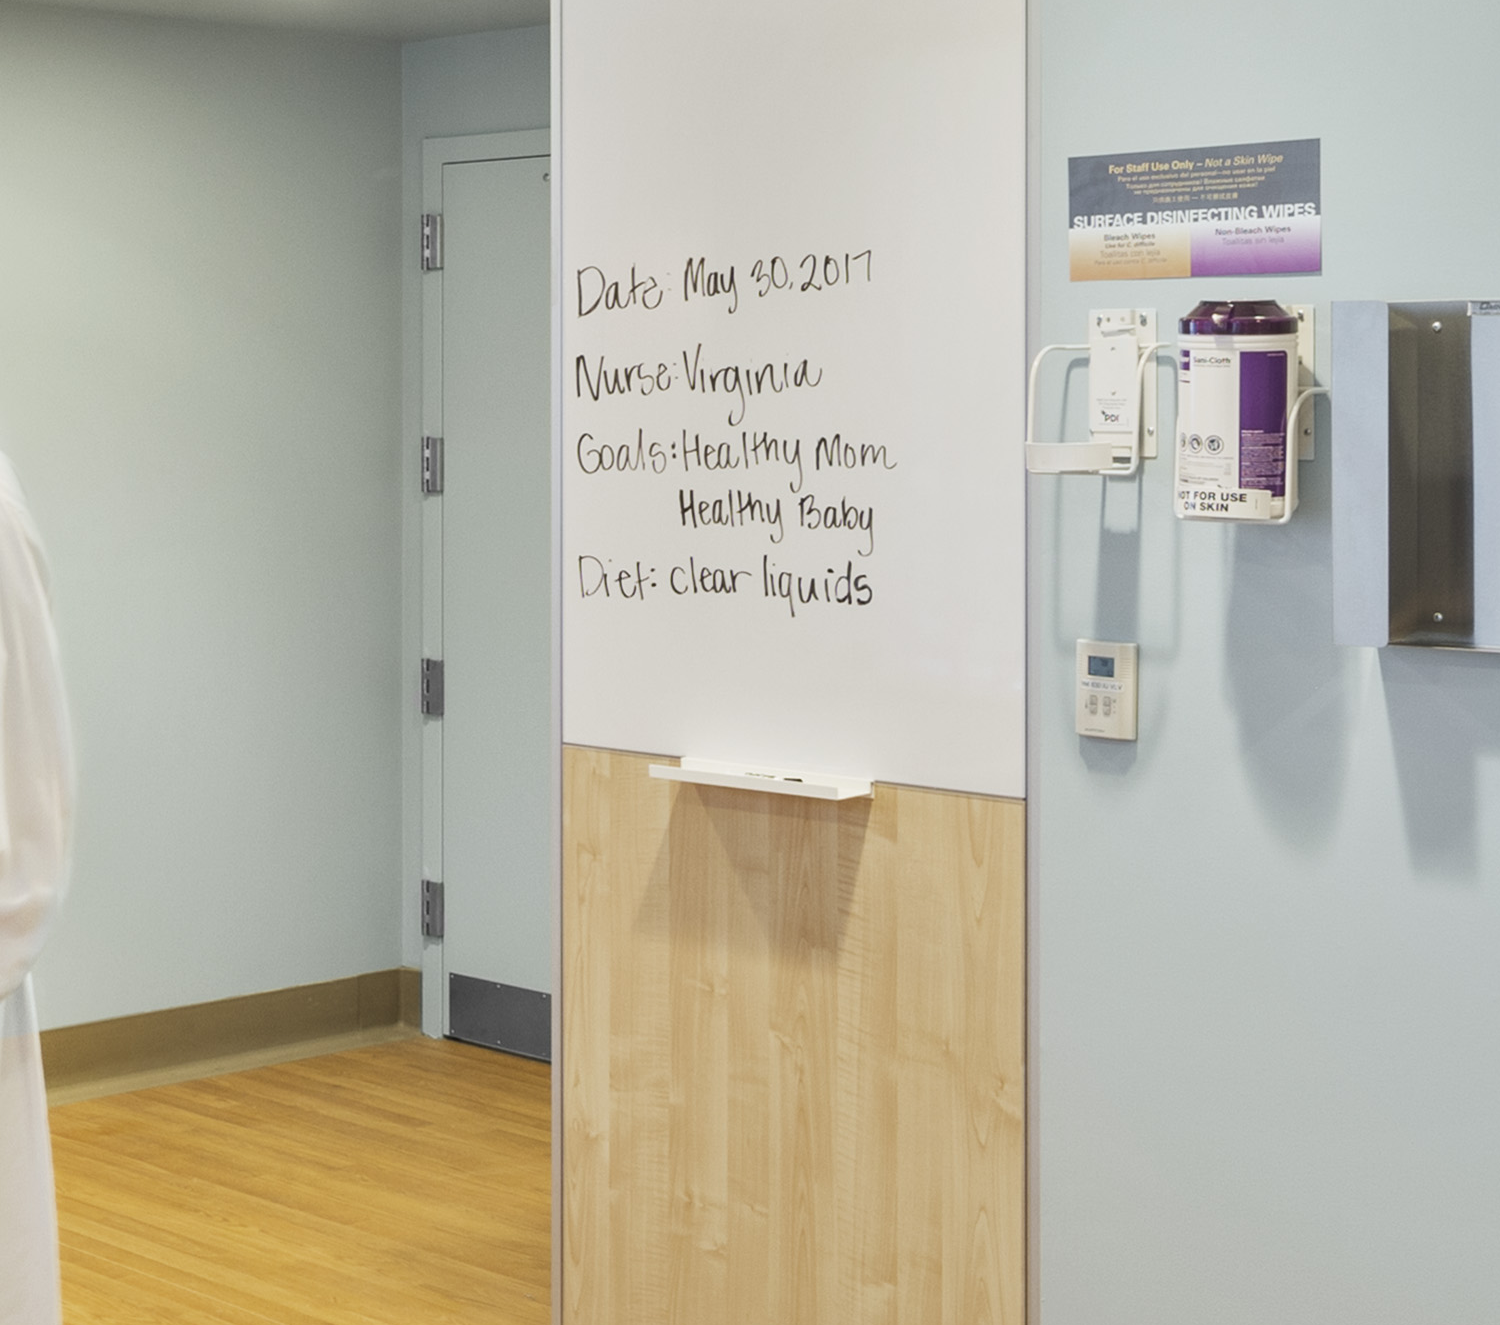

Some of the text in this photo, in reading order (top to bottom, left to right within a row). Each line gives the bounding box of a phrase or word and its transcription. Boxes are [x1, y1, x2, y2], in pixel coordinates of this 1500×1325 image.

[1108, 164, 1124, 174] For
[1126, 162, 1150, 173] Staff
[1151, 161, 1170, 172] Use
[1171, 160, 1195, 171] Only
[1204, 158, 1223, 168] Not
[1233, 155, 1255, 166] Skin
[1257, 153, 1284, 165] Wipe
[1073, 202, 1317, 230] SURFACE DISINFECTING WIPES
[1103, 233, 1156, 241] Bleach Wipes
[1215, 226, 1291, 235] Non-Bleach Wipes
[683, 257, 738, 315] May
[815, 432, 898, 471] Mom
[1183, 501, 1229, 512] ON SKIN
[1193, 491, 1216, 501] FOR
[1220, 492, 1248, 503] USE
[679, 489, 875, 557] Healthy Baby
[577, 554, 874, 618] Diet: clear liquids
